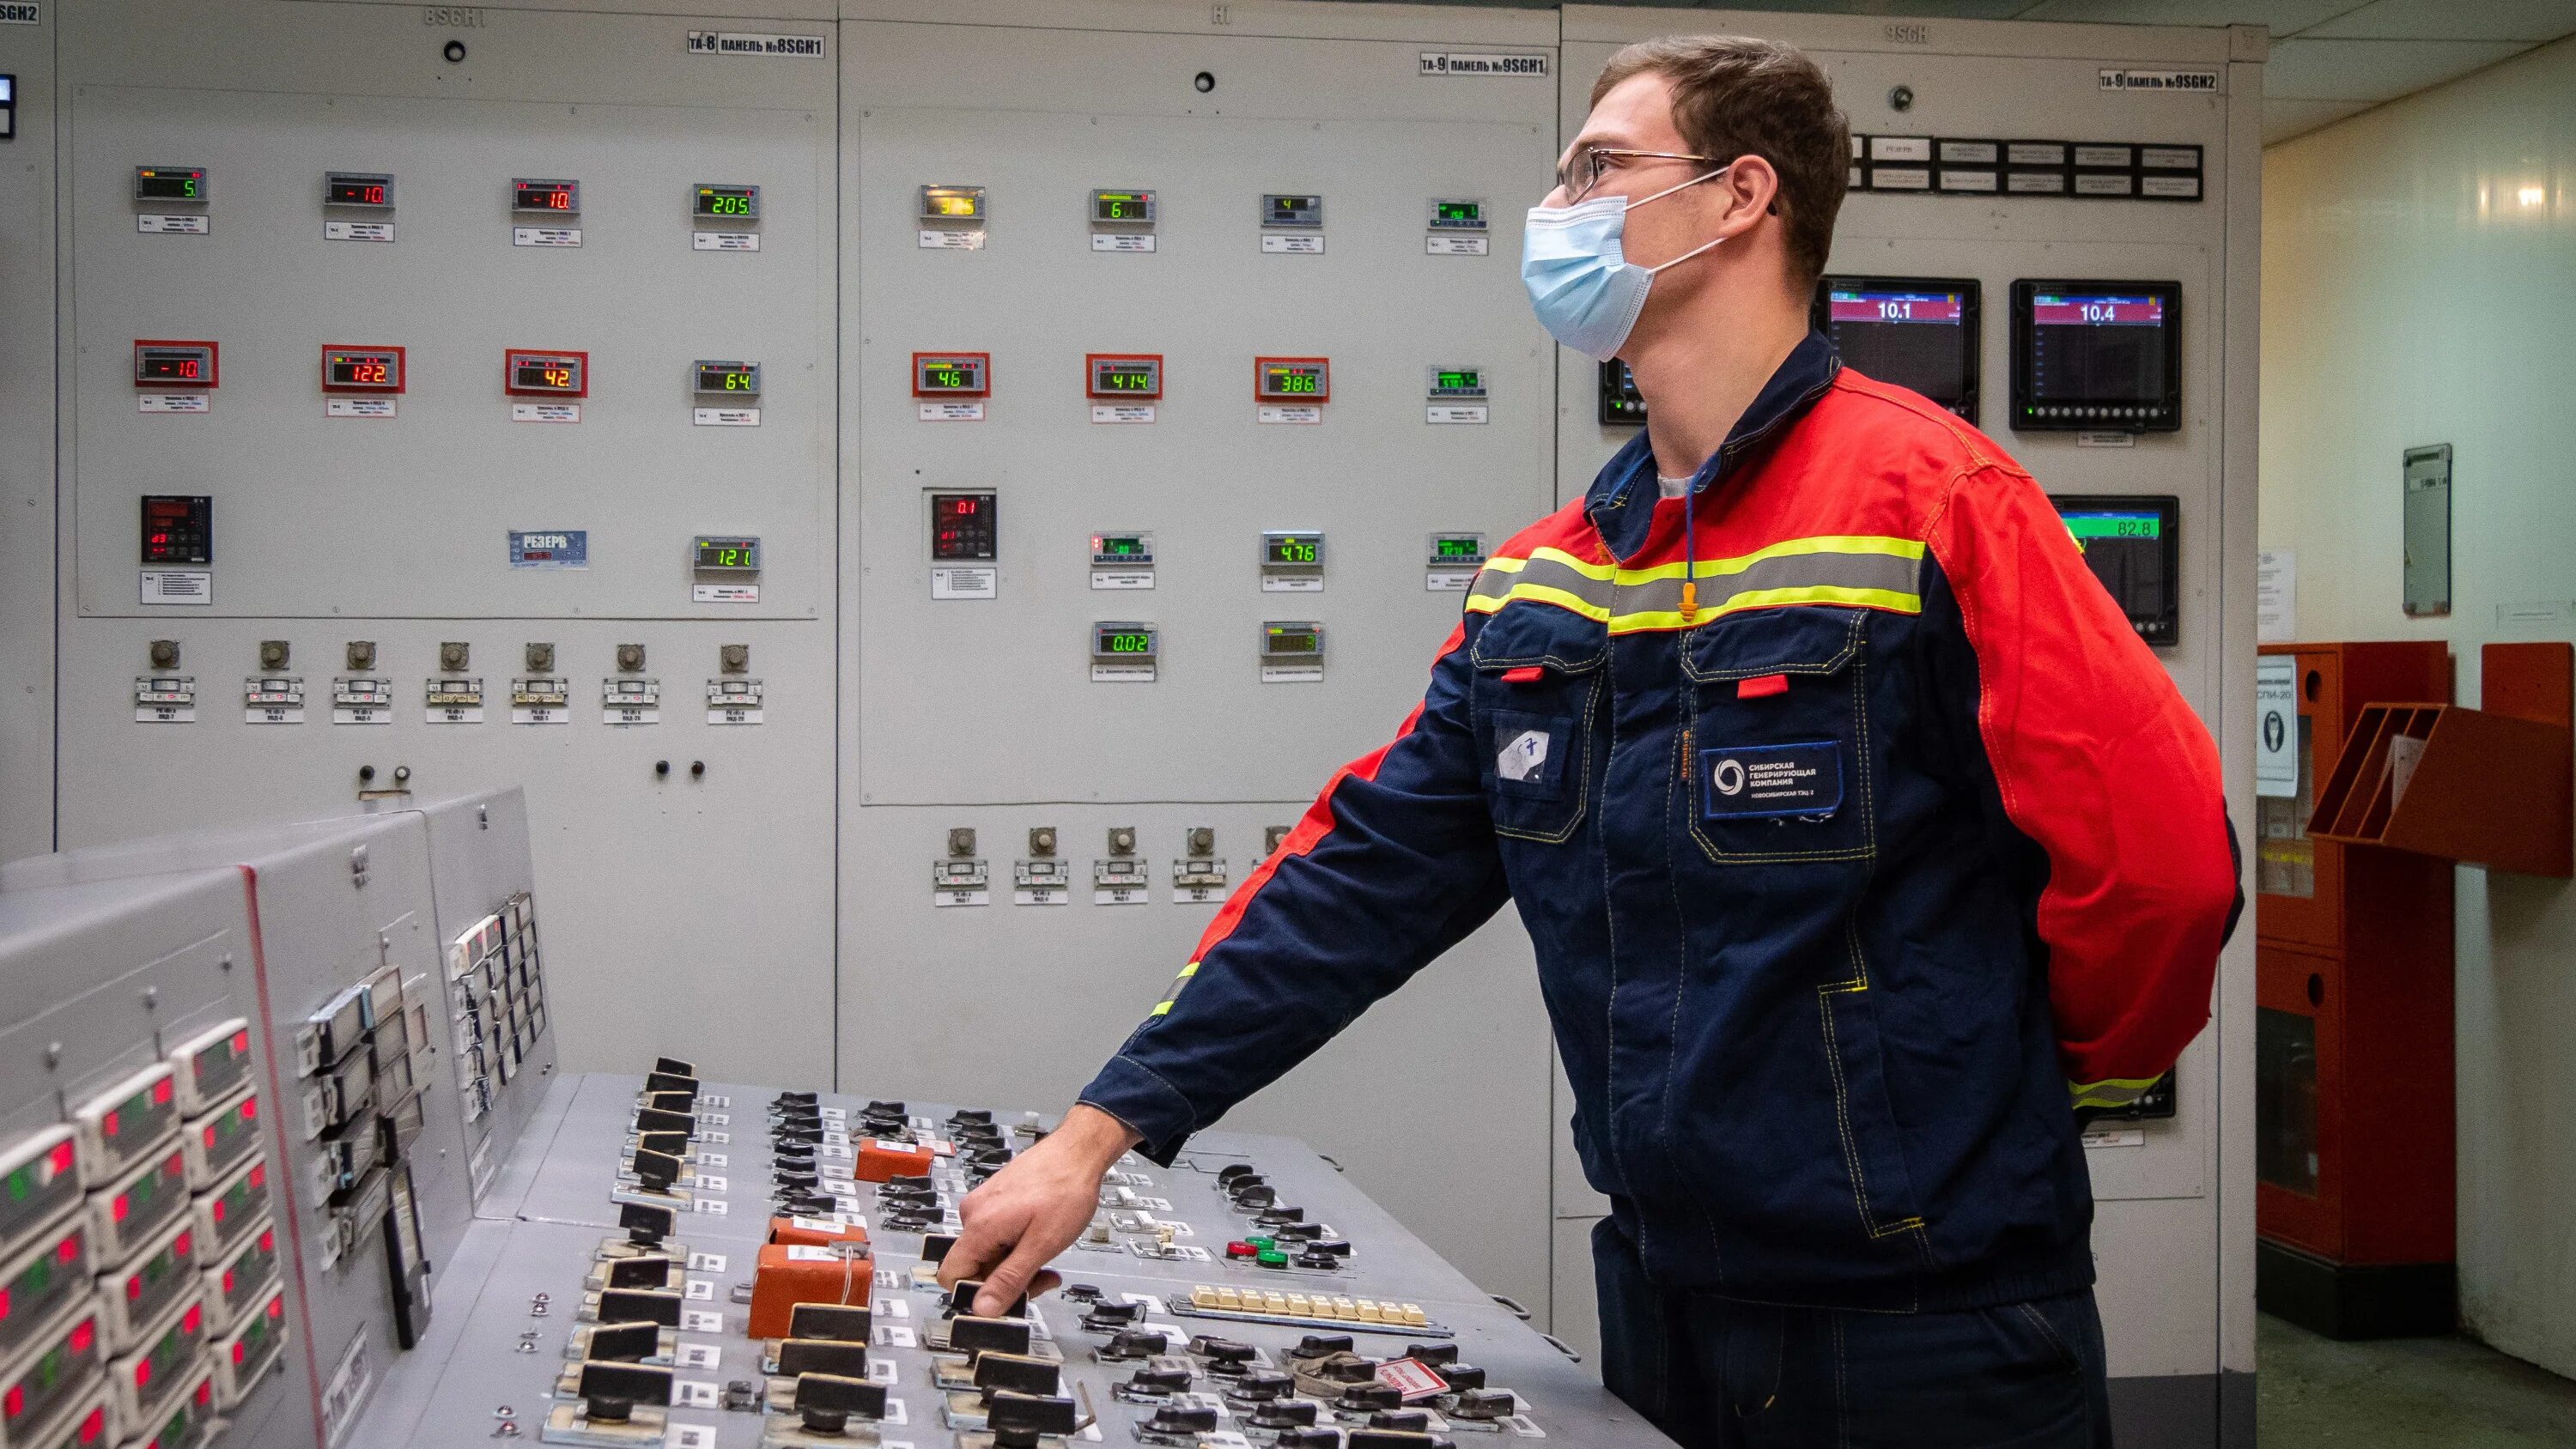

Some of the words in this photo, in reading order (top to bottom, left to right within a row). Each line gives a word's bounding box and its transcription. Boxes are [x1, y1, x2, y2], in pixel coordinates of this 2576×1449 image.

[690, 35, 715, 52] ТА-8
[720, 39, 763, 53] ПАНЕЛЬ
[765, 37, 822, 56] №8SGH1
[1421, 57, 1446, 72] ТА-9
[1450, 60, 1490, 73] ПАНЕЛЬ
[1491, 58, 1545, 74] №9SGH1
[2099, 74, 2123, 88] ТА-9
[2127, 76, 2163, 90] ПАНЕЛЬ
[2165, 75, 2216, 91] №9SGH2
[1878, 302, 1911, 319] 10.1
[2081, 305, 2115, 321] 10.4
[938, 372, 960, 387] 46
[2117, 522, 2151, 537] 82.8
[524, 535, 567, 550] РЕЗЕРВ
[1281, 545, 1315, 562] 4.76
[1113, 635, 1148, 652] 0.02
[1748, 761, 1795, 772] СИБИРСКАЯ
[1749, 768, 1816, 779] ГЕНЕРИРУЮЩАЯ
[1750, 778, 1794, 787] КОМПАНИЯ
